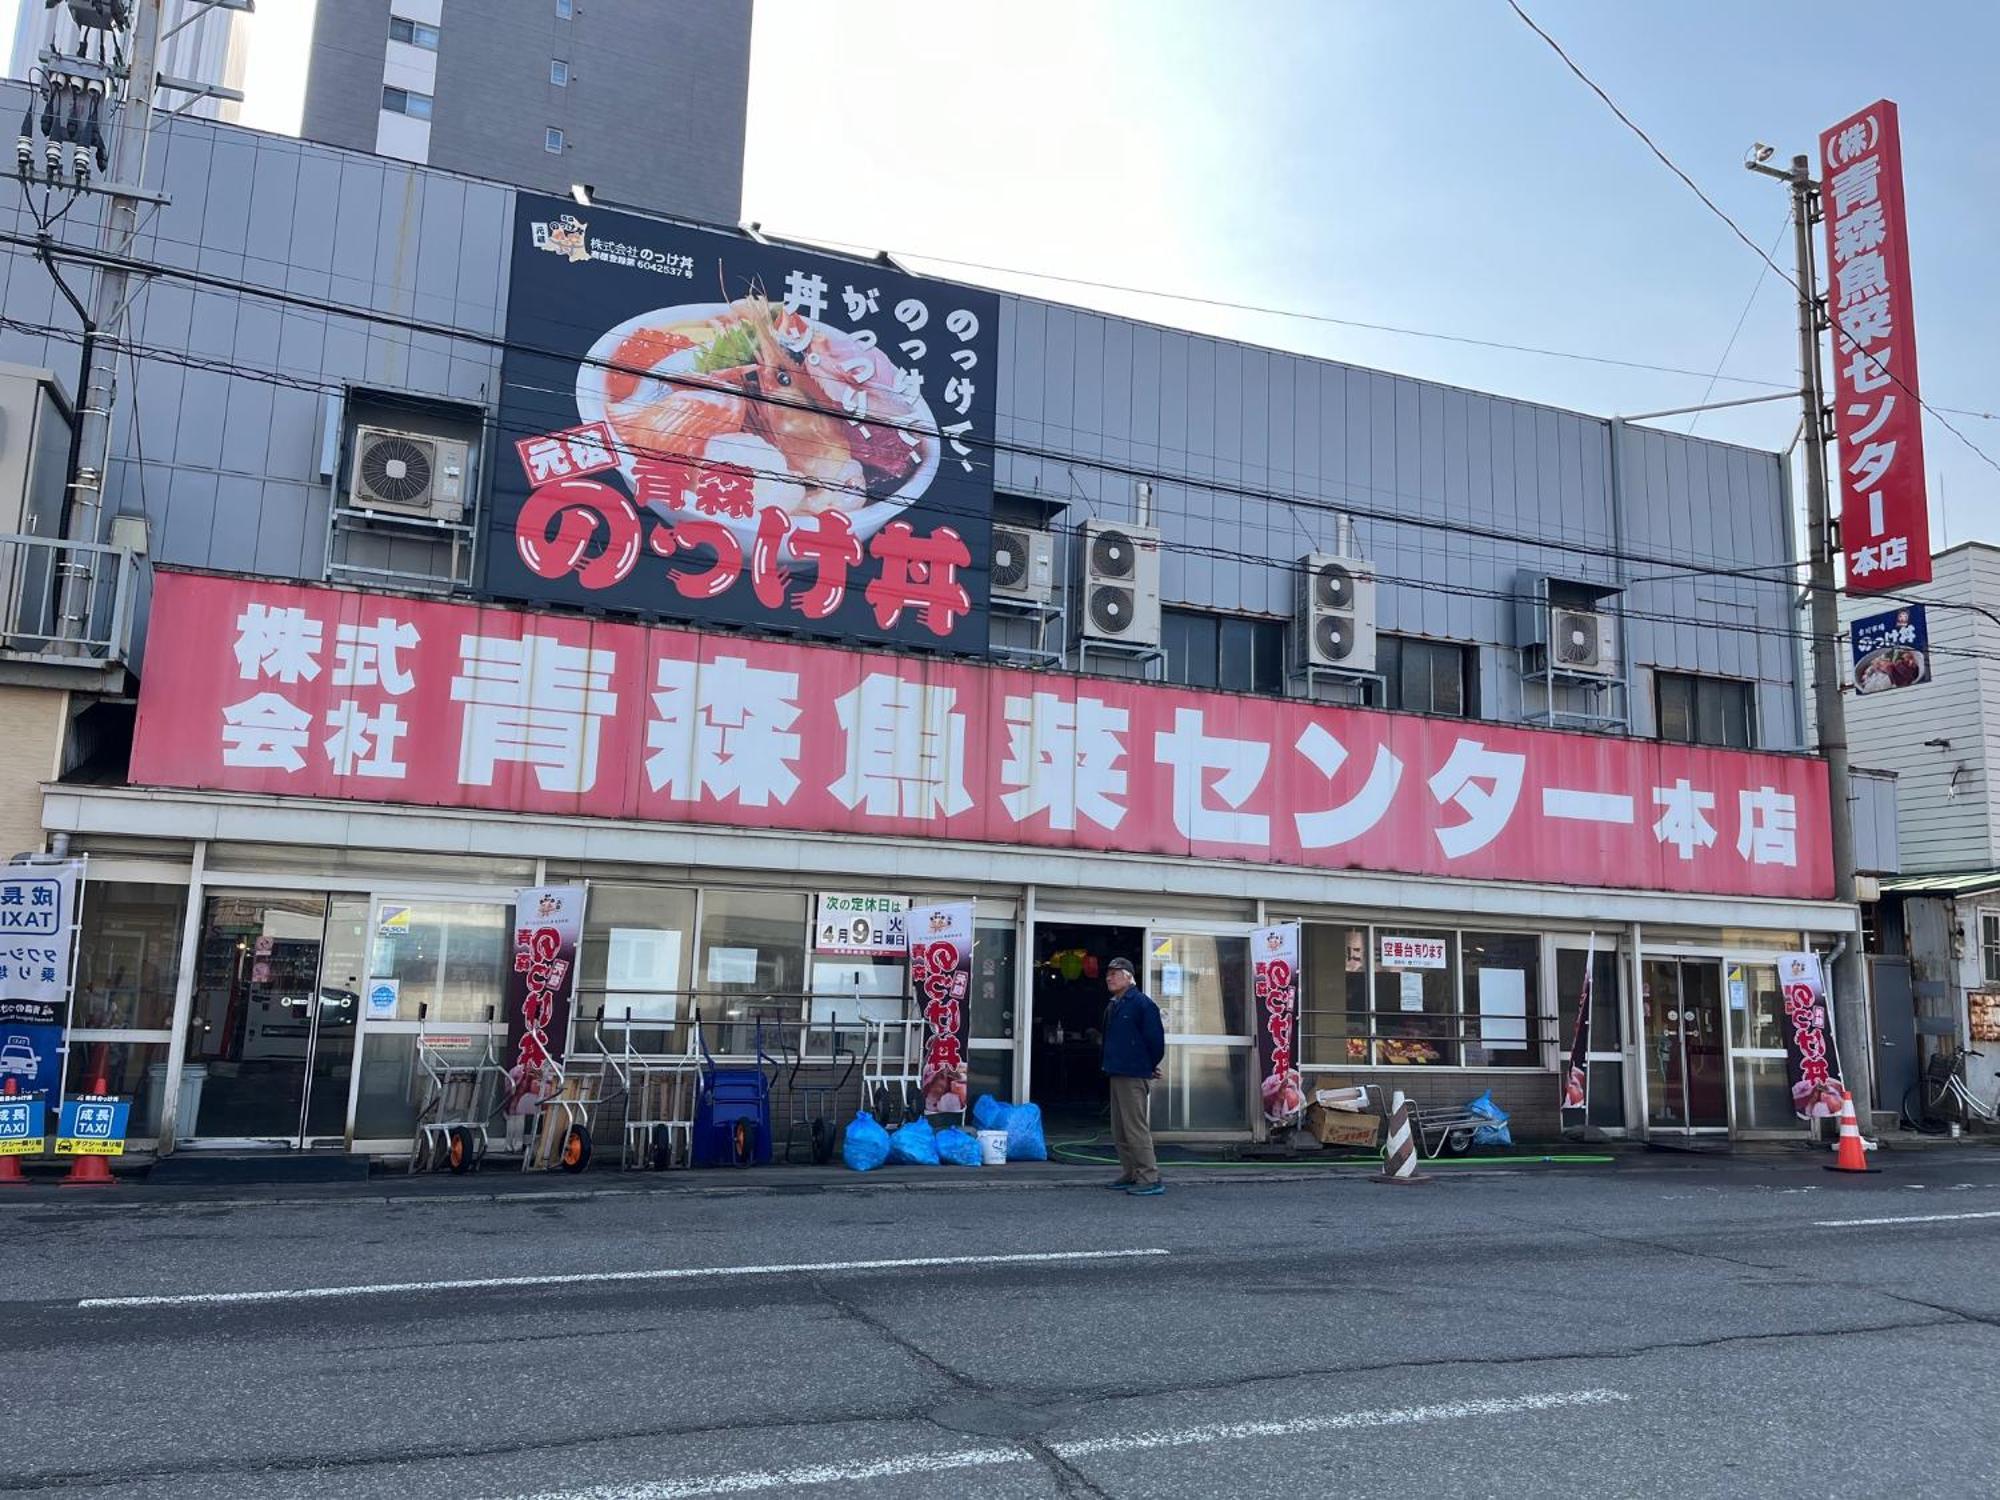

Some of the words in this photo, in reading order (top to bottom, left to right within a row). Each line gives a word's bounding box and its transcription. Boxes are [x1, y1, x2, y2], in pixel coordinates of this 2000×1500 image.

[515, 480, 972, 638] のっけ丼
[1850, 535, 1908, 578] 本店
[232, 603, 422, 697] 株式
[220, 691, 409, 780] 会社
[826, 895, 901, 913] 次の定休日は
[78, 1123, 107, 1134] TAXI
[80, 1109, 110, 1121] 成長
